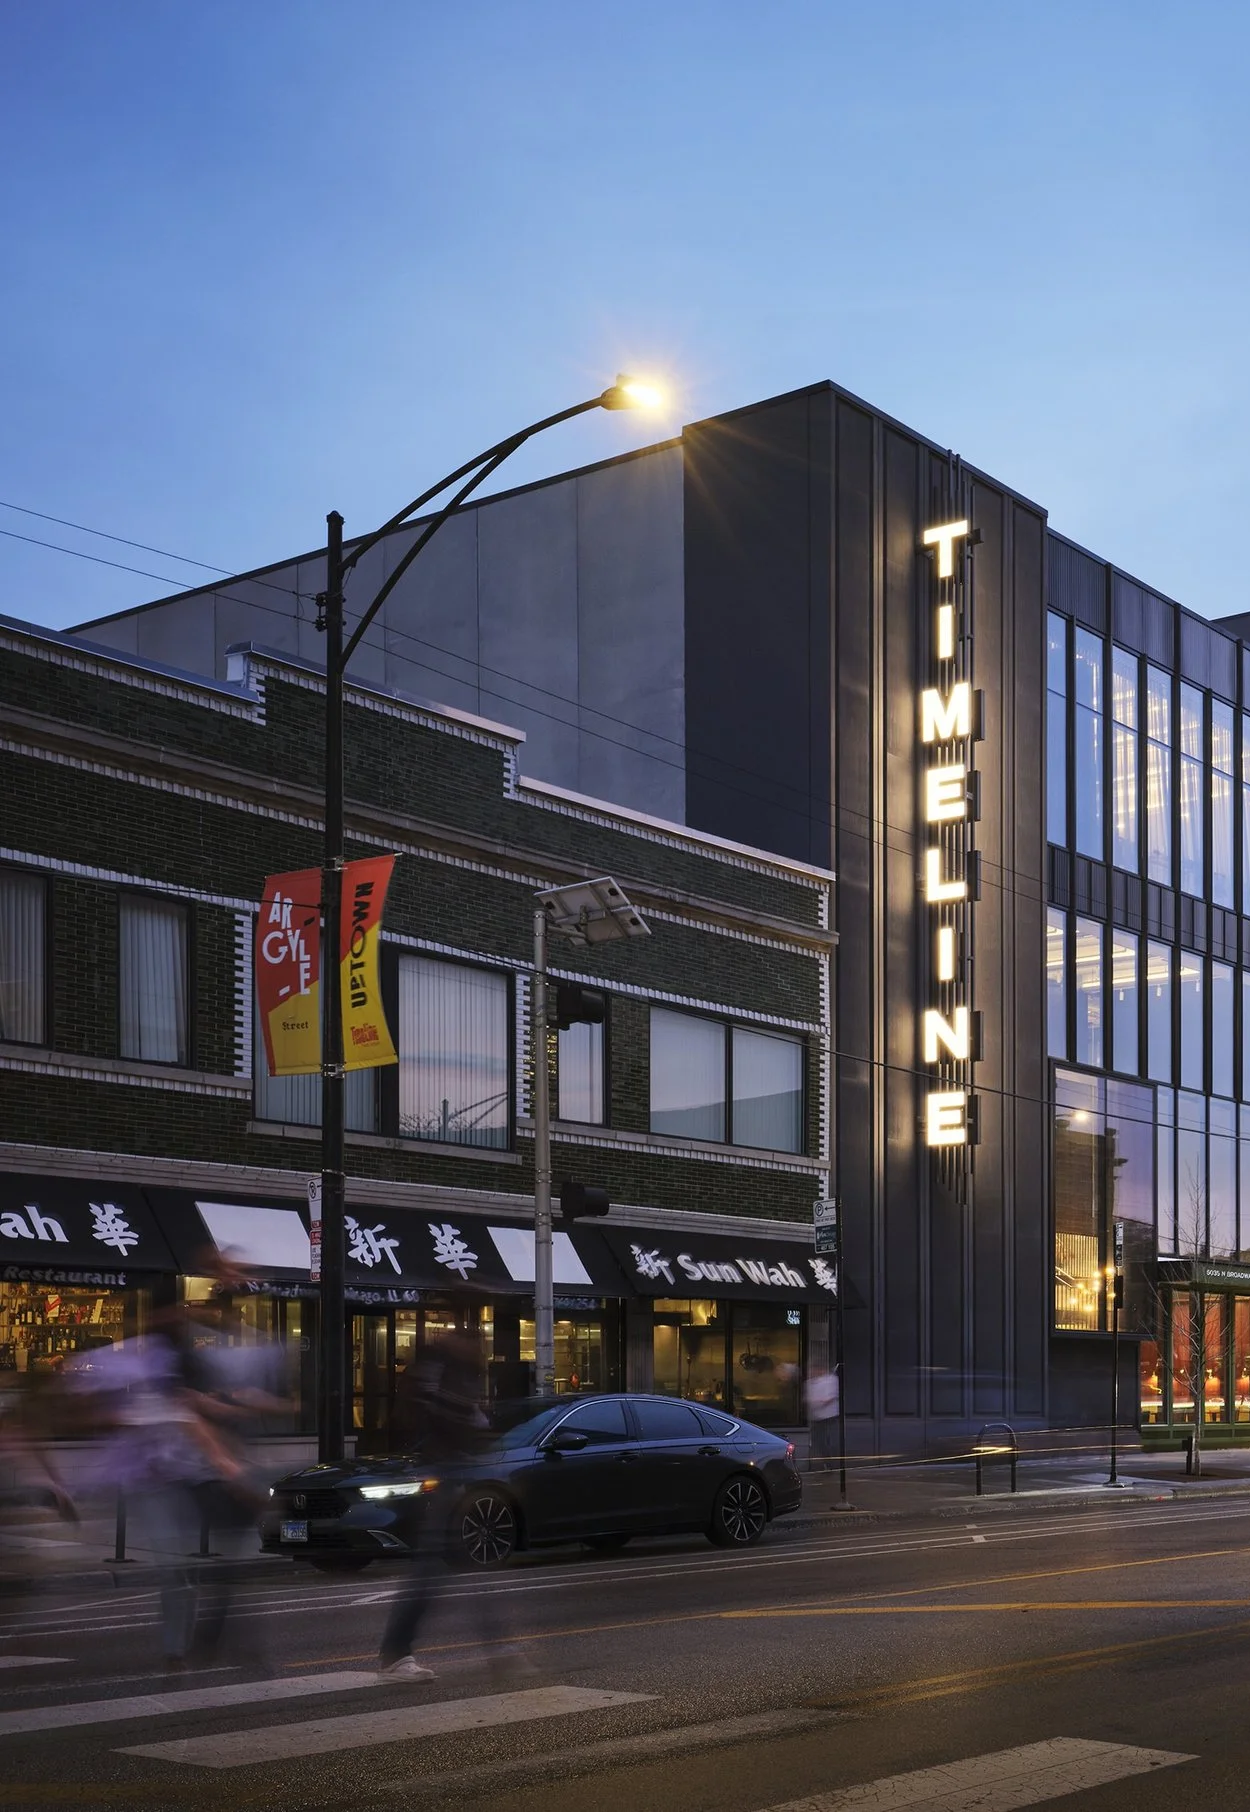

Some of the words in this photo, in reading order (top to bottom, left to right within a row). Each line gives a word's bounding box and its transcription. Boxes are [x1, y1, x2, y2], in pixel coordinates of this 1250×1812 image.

[922, 519, 971, 1147] TIMELINE
[350, 881, 375, 1009] UPTOWN
[282, 1020, 309, 1031] Street
[88, 1202, 139, 1257] 華
[4, 1265, 126, 1286] Restaurant
[630, 1244, 676, 1286] 新
[676, 1252, 744, 1284] Sun
[734, 1256, 808, 1289] Wah
